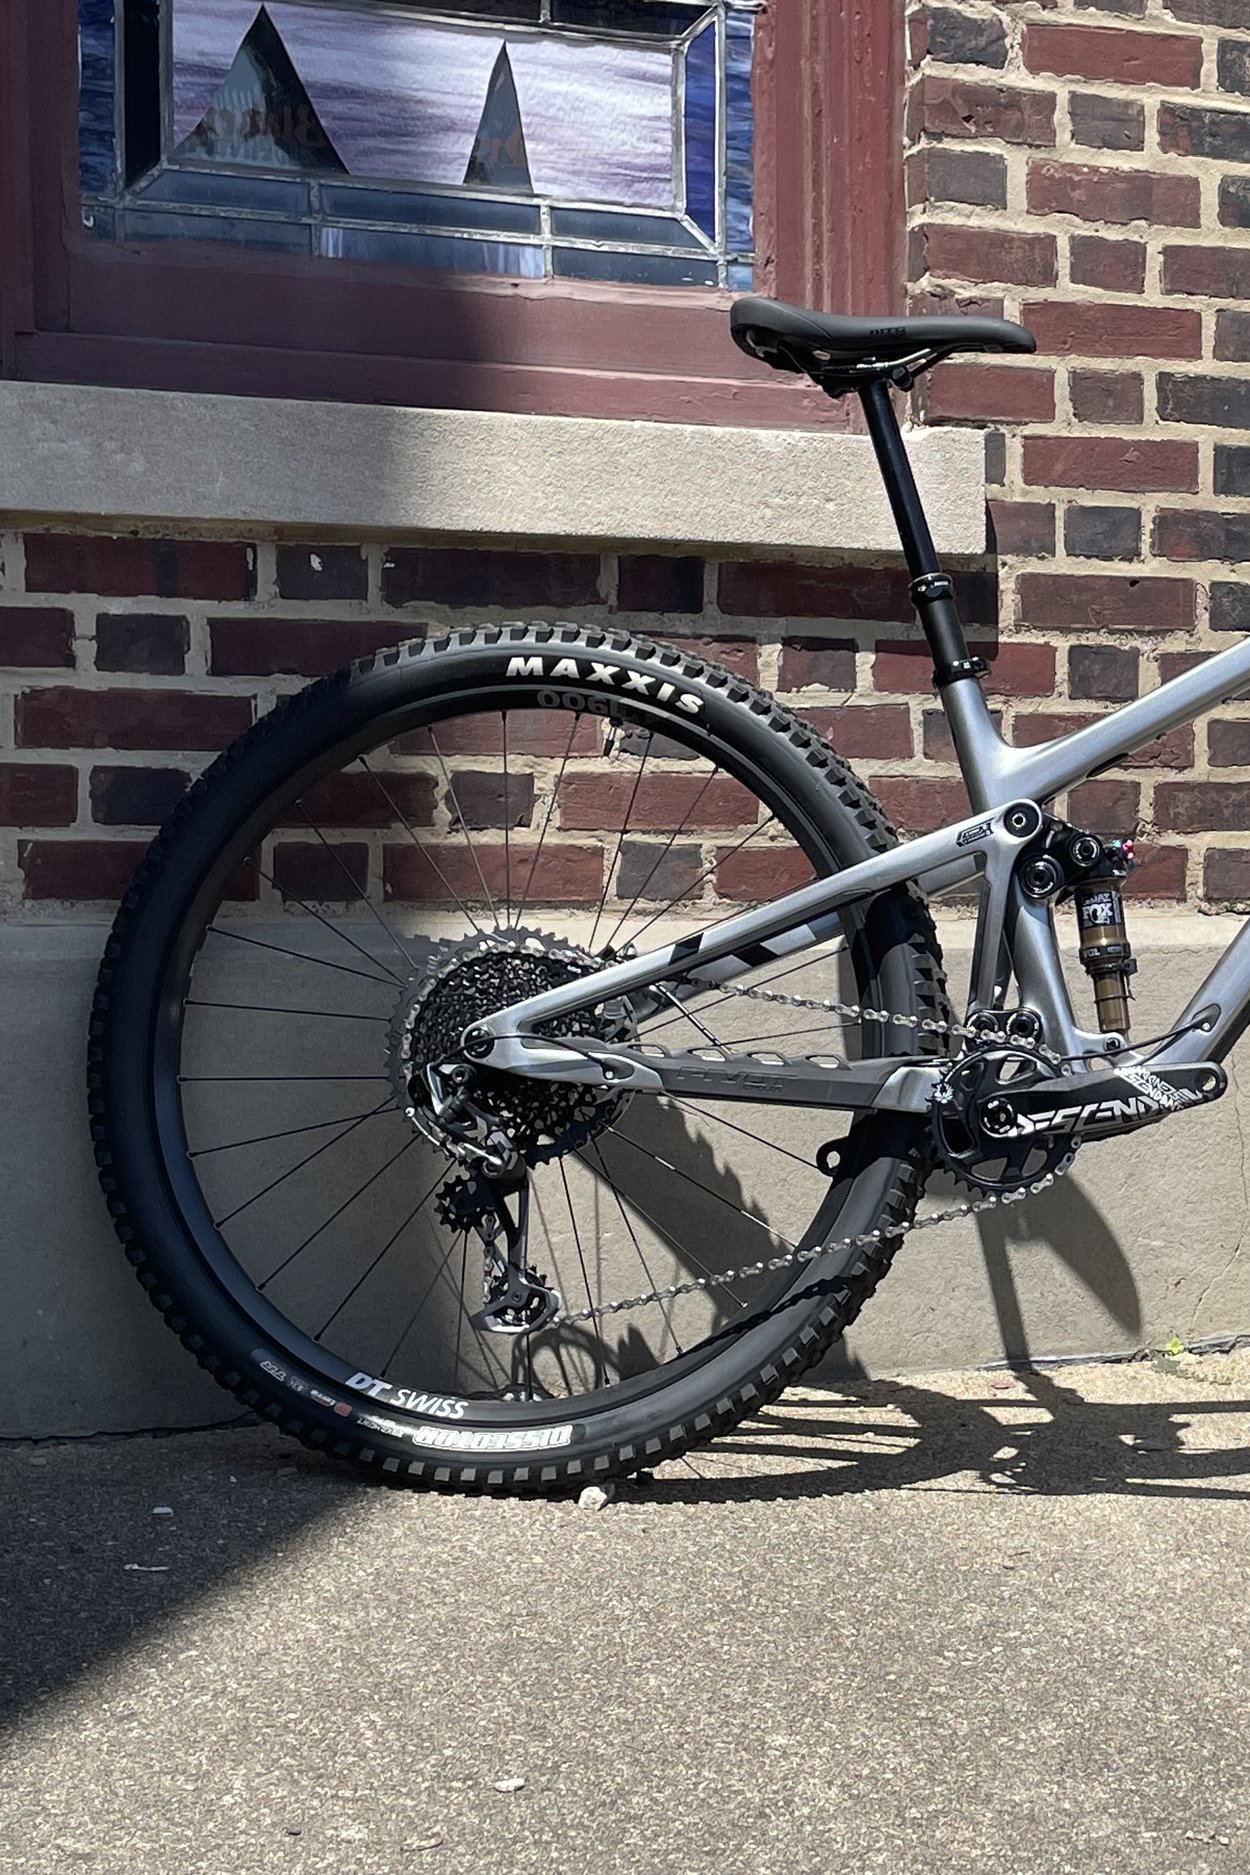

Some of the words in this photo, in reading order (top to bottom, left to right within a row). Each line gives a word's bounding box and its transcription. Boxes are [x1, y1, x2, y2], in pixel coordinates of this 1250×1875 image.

[505, 656, 705, 714] MAXXIS
[1082, 902, 1113, 925] FOX
[344, 1371, 393, 1397] DT
[389, 1388, 470, 1419] SWISS
[411, 1424, 573, 1451] DISSECTOR
